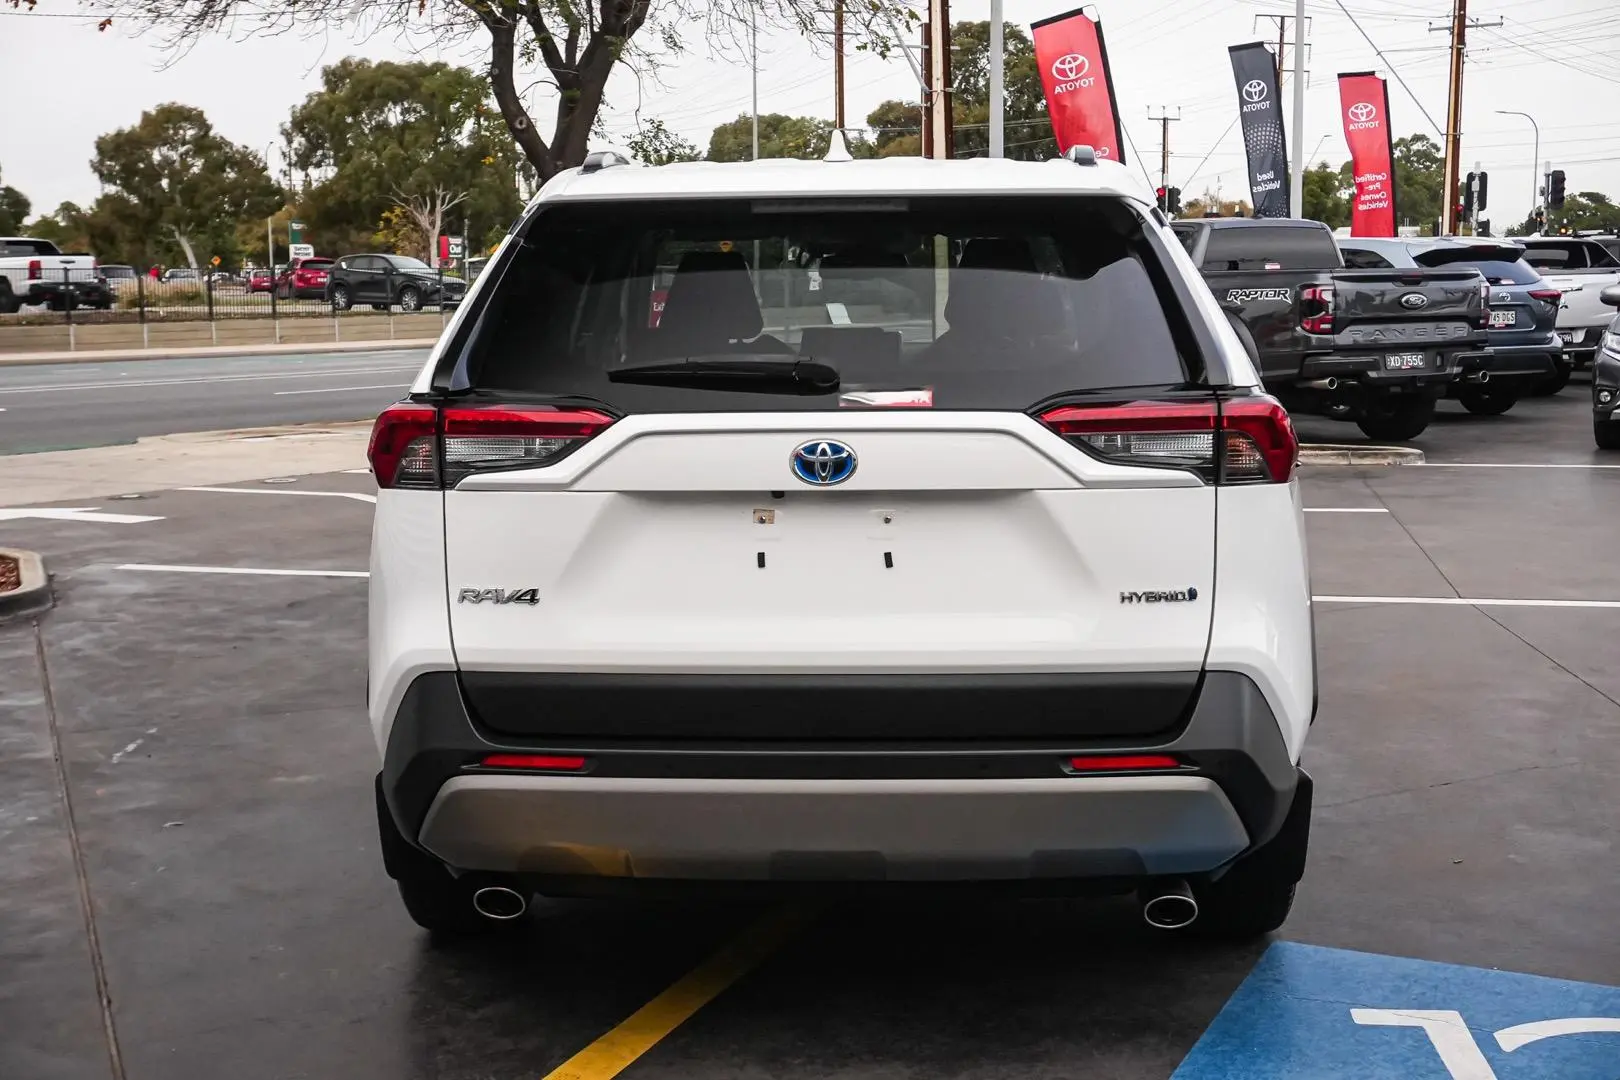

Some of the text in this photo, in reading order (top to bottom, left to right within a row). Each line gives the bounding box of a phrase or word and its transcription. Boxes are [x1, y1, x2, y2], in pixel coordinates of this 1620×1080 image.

[1226, 288, 1293, 305] RAPTOR
[457, 587, 540, 606] RAV4
[1120, 590, 1187, 604] HYBRID
